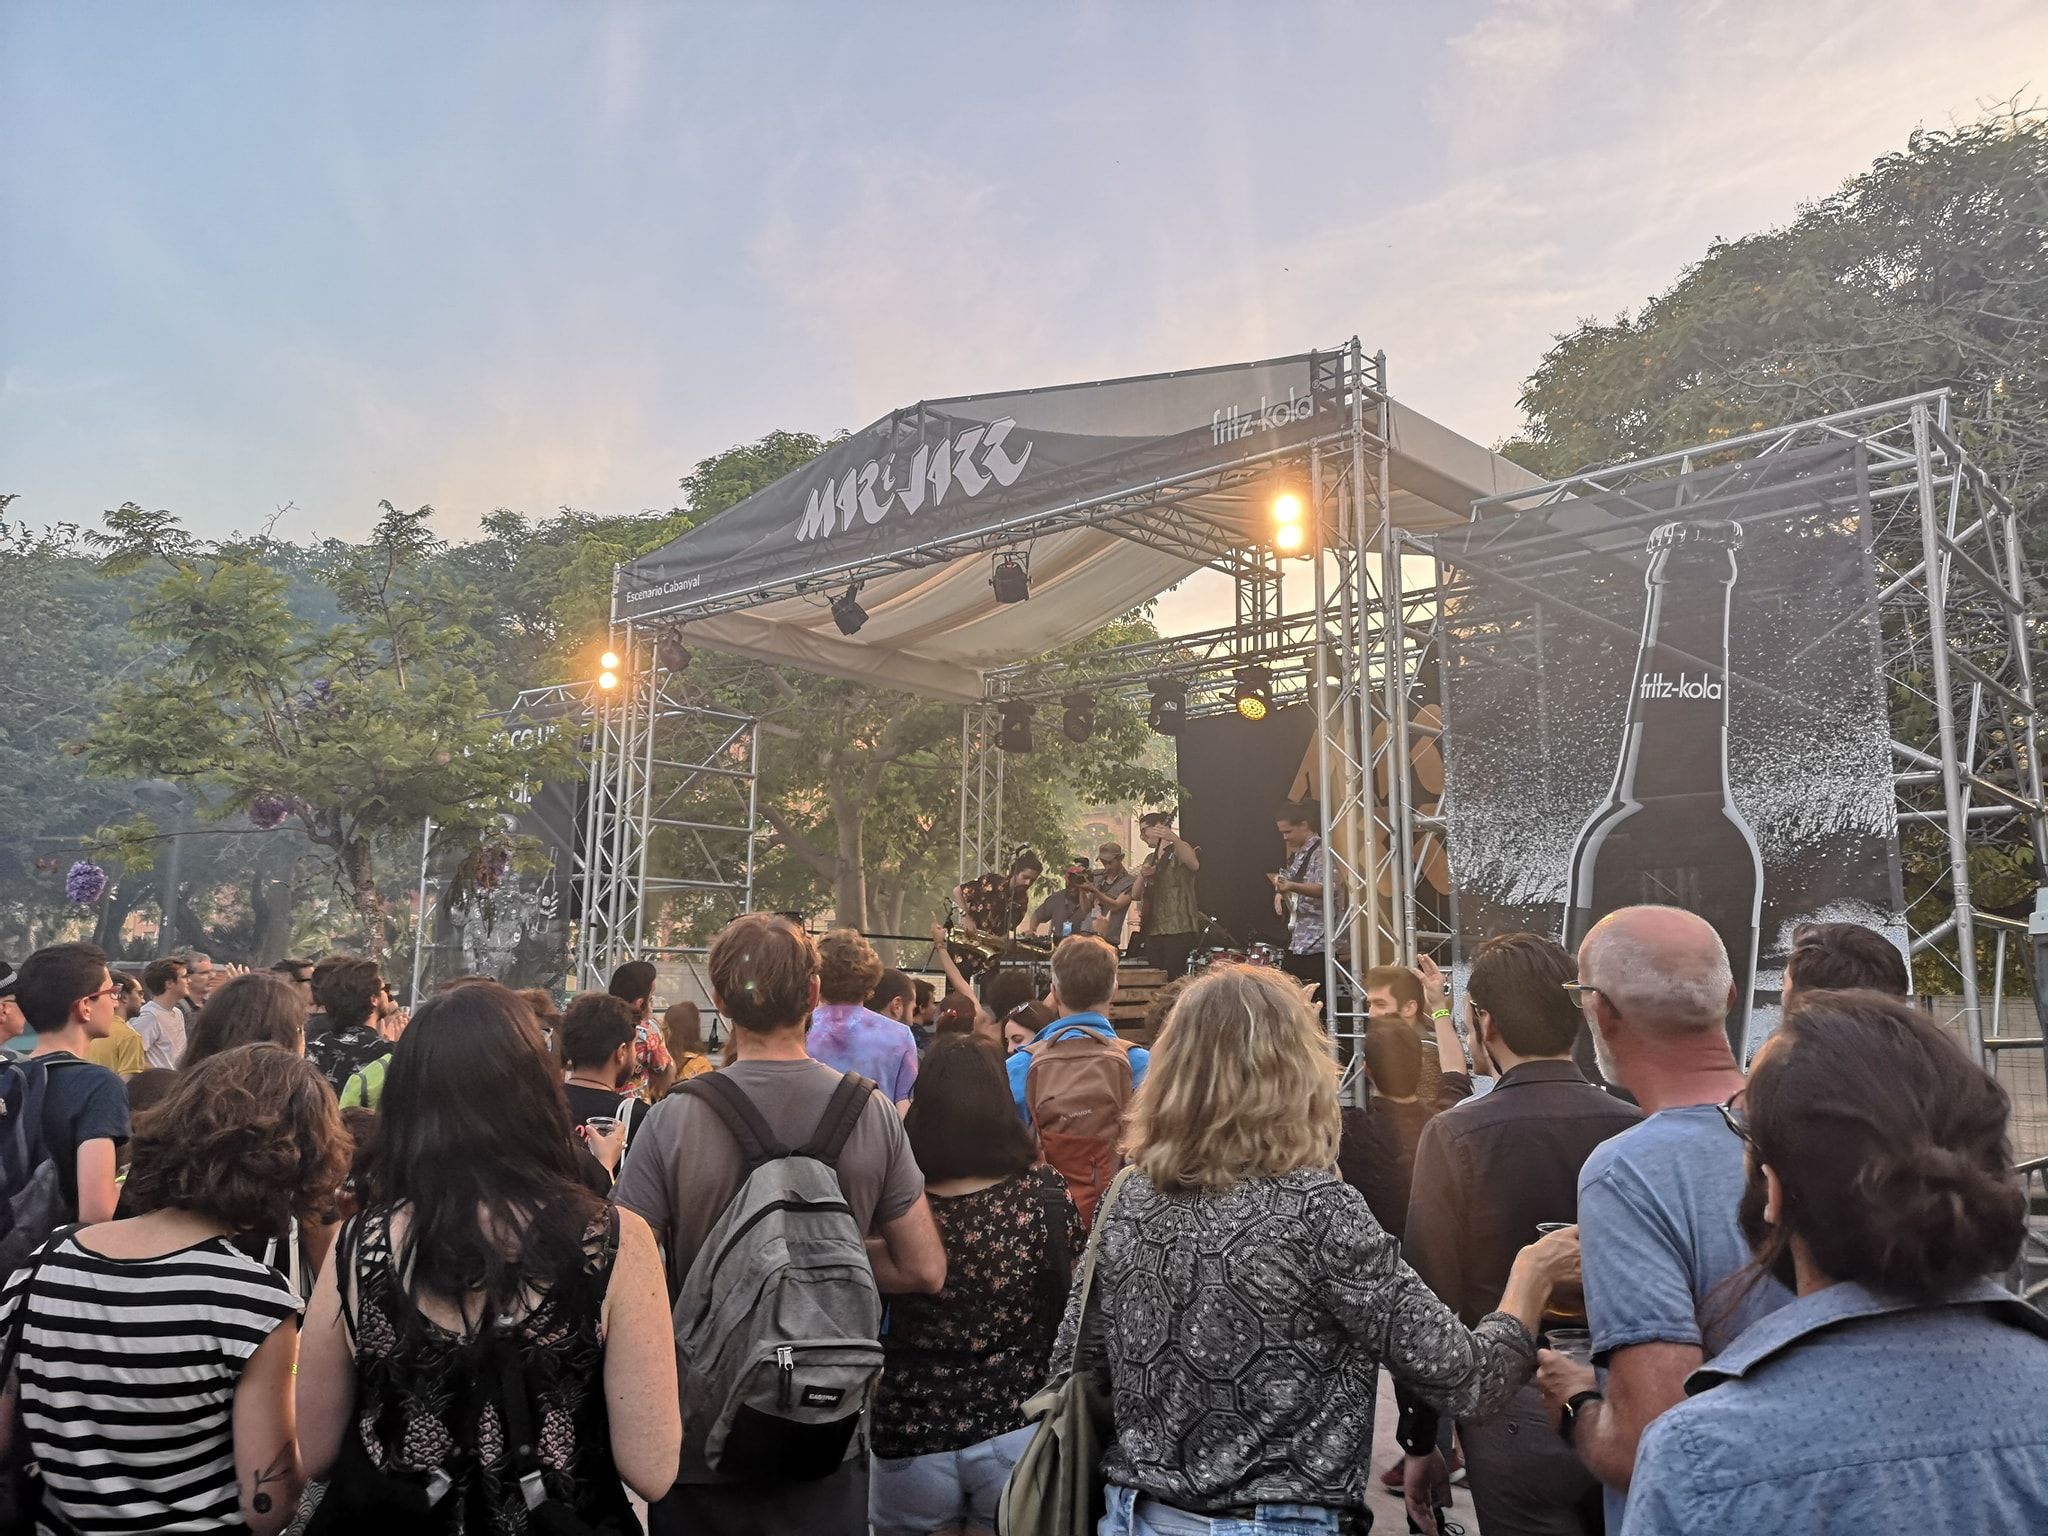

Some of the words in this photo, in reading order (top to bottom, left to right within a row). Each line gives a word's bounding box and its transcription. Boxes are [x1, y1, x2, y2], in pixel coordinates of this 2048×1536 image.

[1211, 386, 1314, 446] fritz-kola
[626, 584, 663, 603] Escenario
[663, 574, 700, 594] Cabanyal
[1640, 672, 1722, 700] fritz-kola
